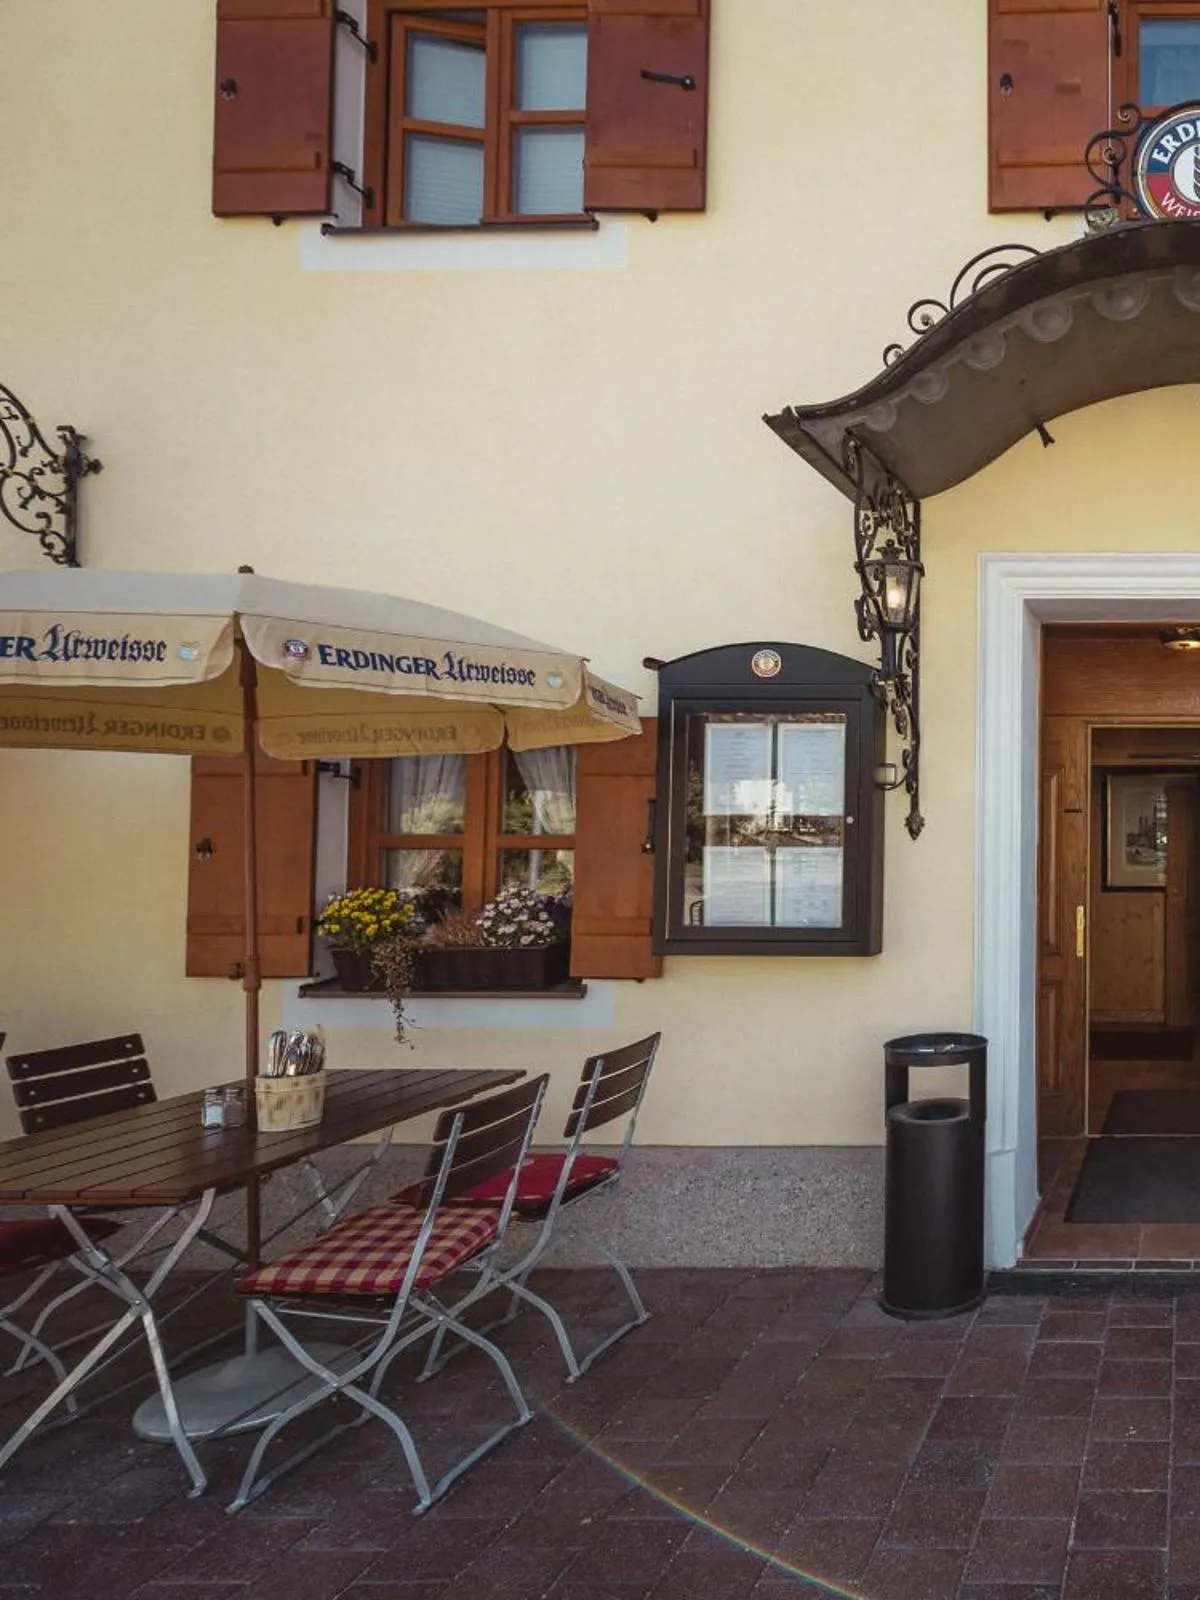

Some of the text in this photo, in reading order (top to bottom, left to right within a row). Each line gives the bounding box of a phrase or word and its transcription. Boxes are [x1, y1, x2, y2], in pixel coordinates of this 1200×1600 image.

[38, 623, 167, 662] Urweisse
[318, 645, 441, 680] ERDINGER
[441, 651, 536, 688] Urweisse
